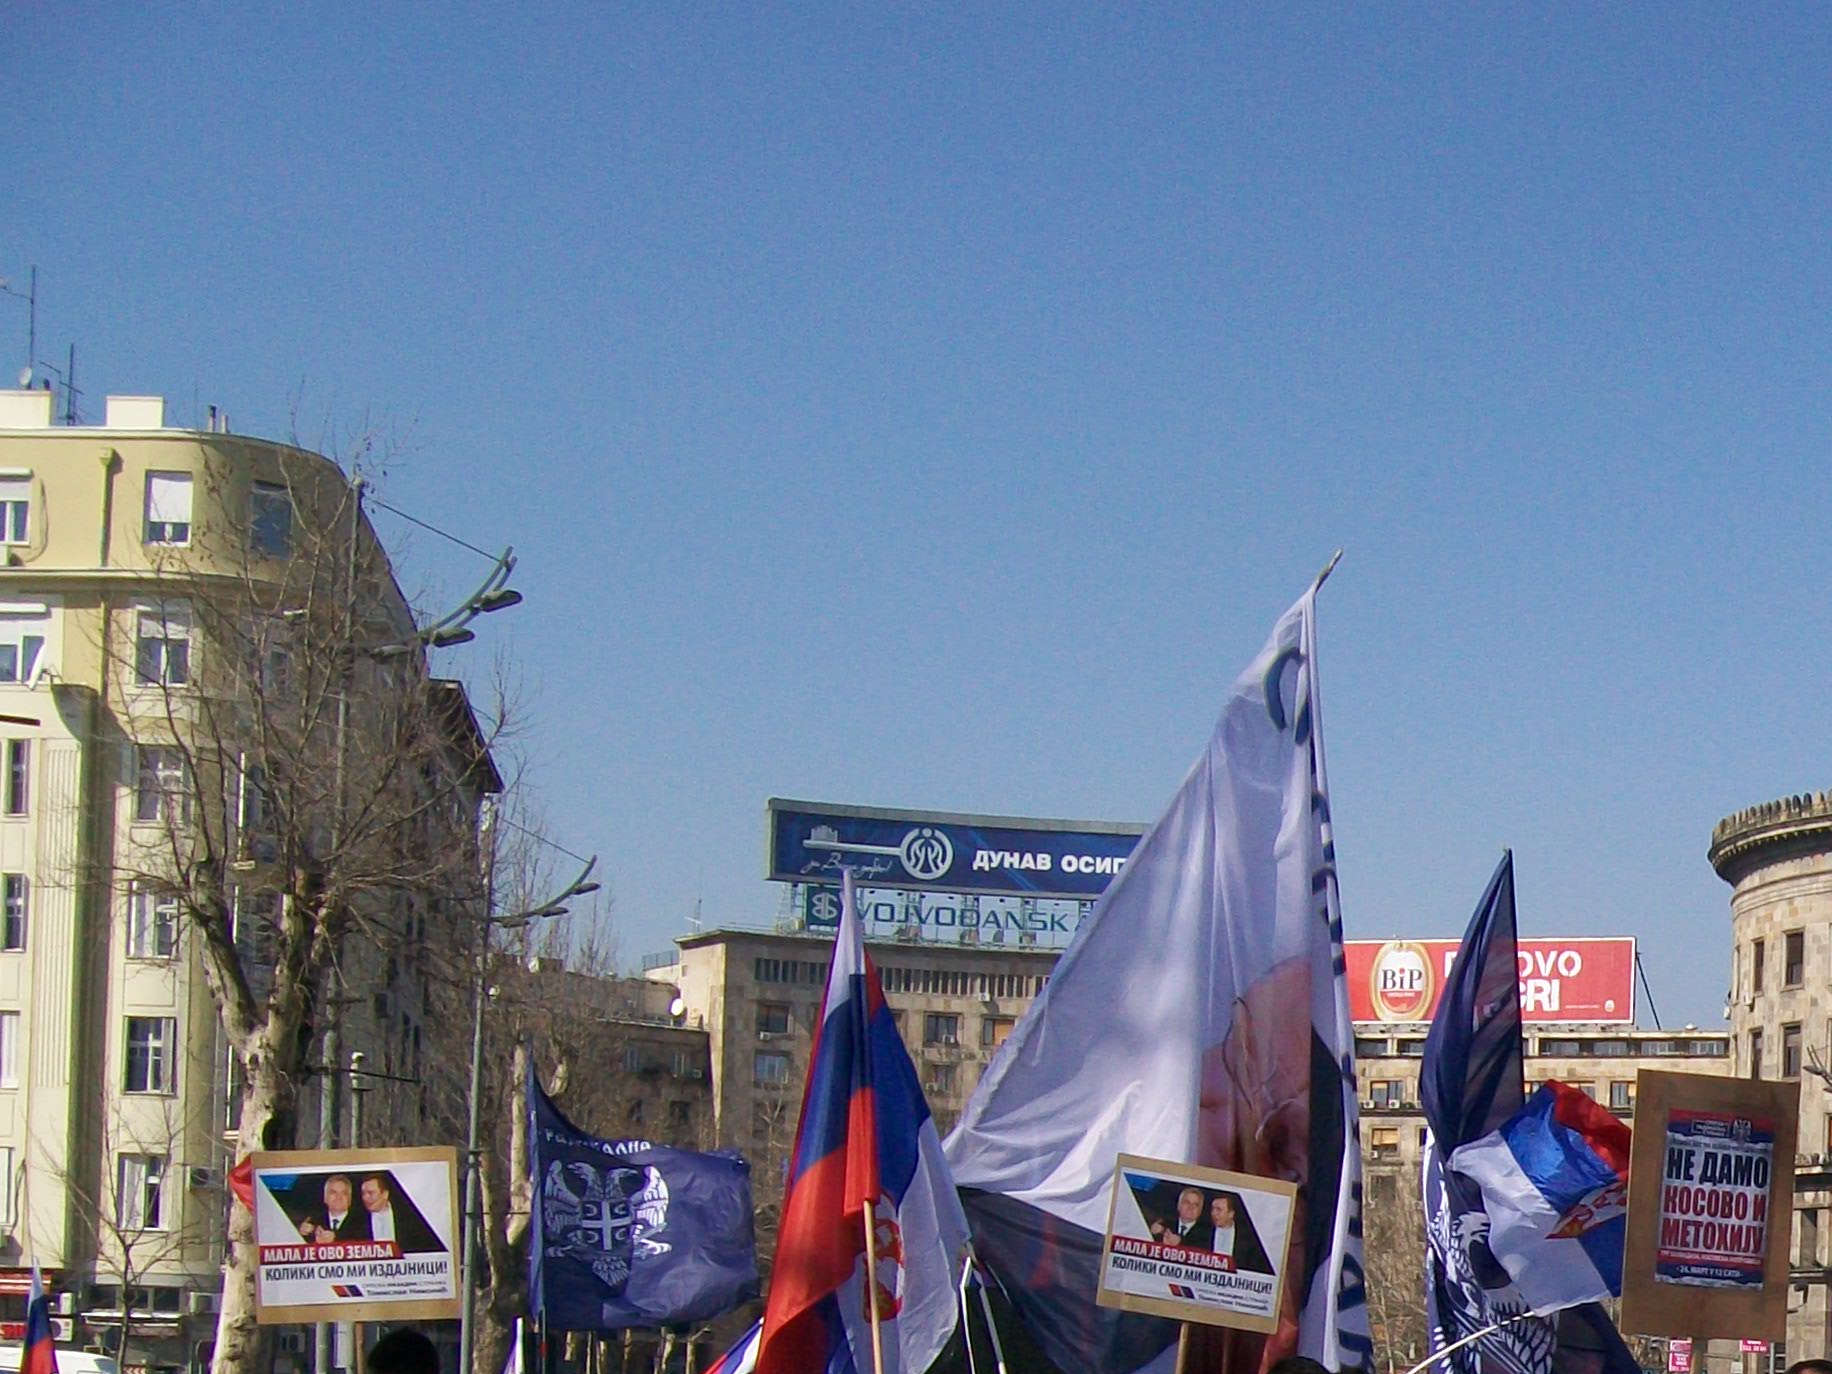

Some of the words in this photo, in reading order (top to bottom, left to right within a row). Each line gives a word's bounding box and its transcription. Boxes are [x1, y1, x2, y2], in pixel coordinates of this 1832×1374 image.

[972, 849, 1051, 873] ДУНАВ
[1381, 967, 1423, 990] BiP
[1666, 1148, 1697, 1181] НЕ
[1699, 1151, 1769, 1189] ДАМО
[1663, 1185, 1749, 1221] КОСОВО
[1752, 1194, 1766, 1222] И
[1660, 1218, 1764, 1254] МЕТОХИЈУ
[264, 1248, 300, 1263] МАЛА
[302, 1247, 318, 1262] ЈЕ
[318, 1246, 344, 1261] ОВО
[346, 1244, 393, 1259] ЗЕМЉА
[1113, 1239, 1148, 1255] МАЛА
[1149, 1245, 1162, 1259] ЈЕ
[1162, 1248, 1187, 1262] ОВО
[1188, 1251, 1229, 1271] ЗЕМЉА
[265, 1265, 315, 1281] КОЛИКИ
[318, 1265, 344, 1279] СМО
[346, 1264, 366, 1278] МИ
[369, 1261, 448, 1278] ИЗДАЈНИЦИ!
[1112, 1256, 1157, 1275] КОЛИКИ
[1158, 1264, 1182, 1279] СМО
[1183, 1268, 1202, 1282] МИ
[1204, 1271, 1273, 1295] ИЗДАЈНИЦИ!
